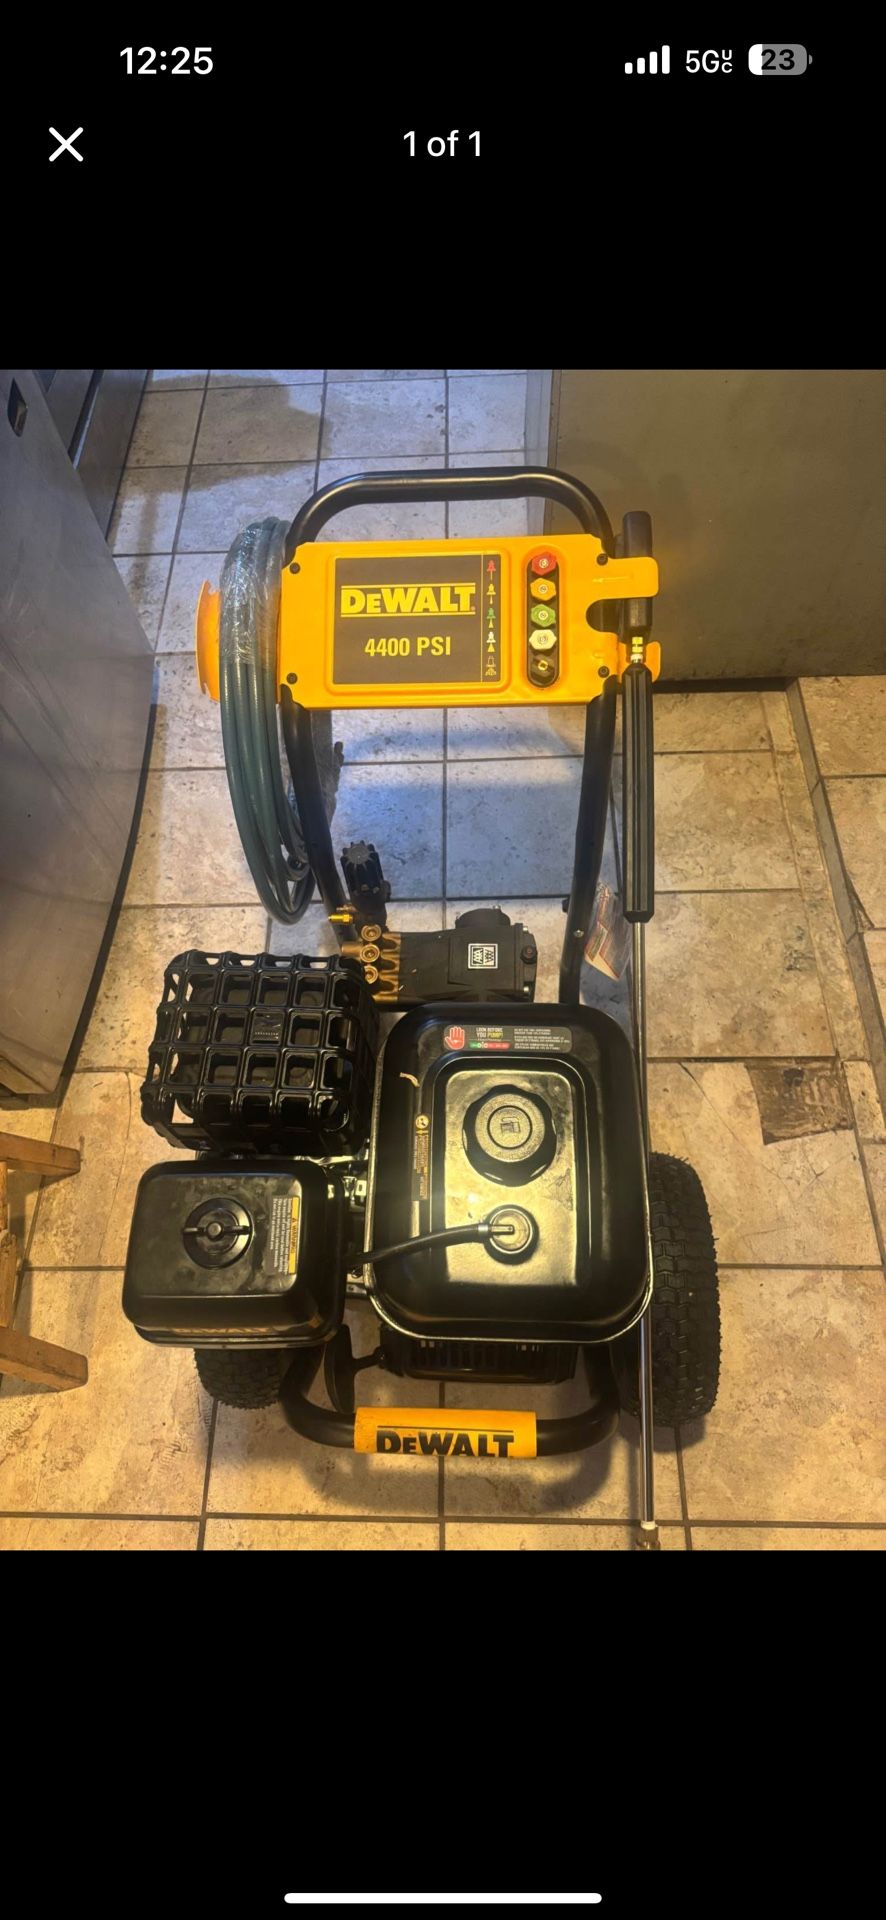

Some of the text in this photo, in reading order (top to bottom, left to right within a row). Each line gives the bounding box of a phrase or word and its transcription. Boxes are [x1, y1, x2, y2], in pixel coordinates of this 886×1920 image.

[341, 586, 476, 614] DEWALT
[364, 636, 452, 657] 4400 PSI
[376, 1429, 515, 1458] DEWALT
